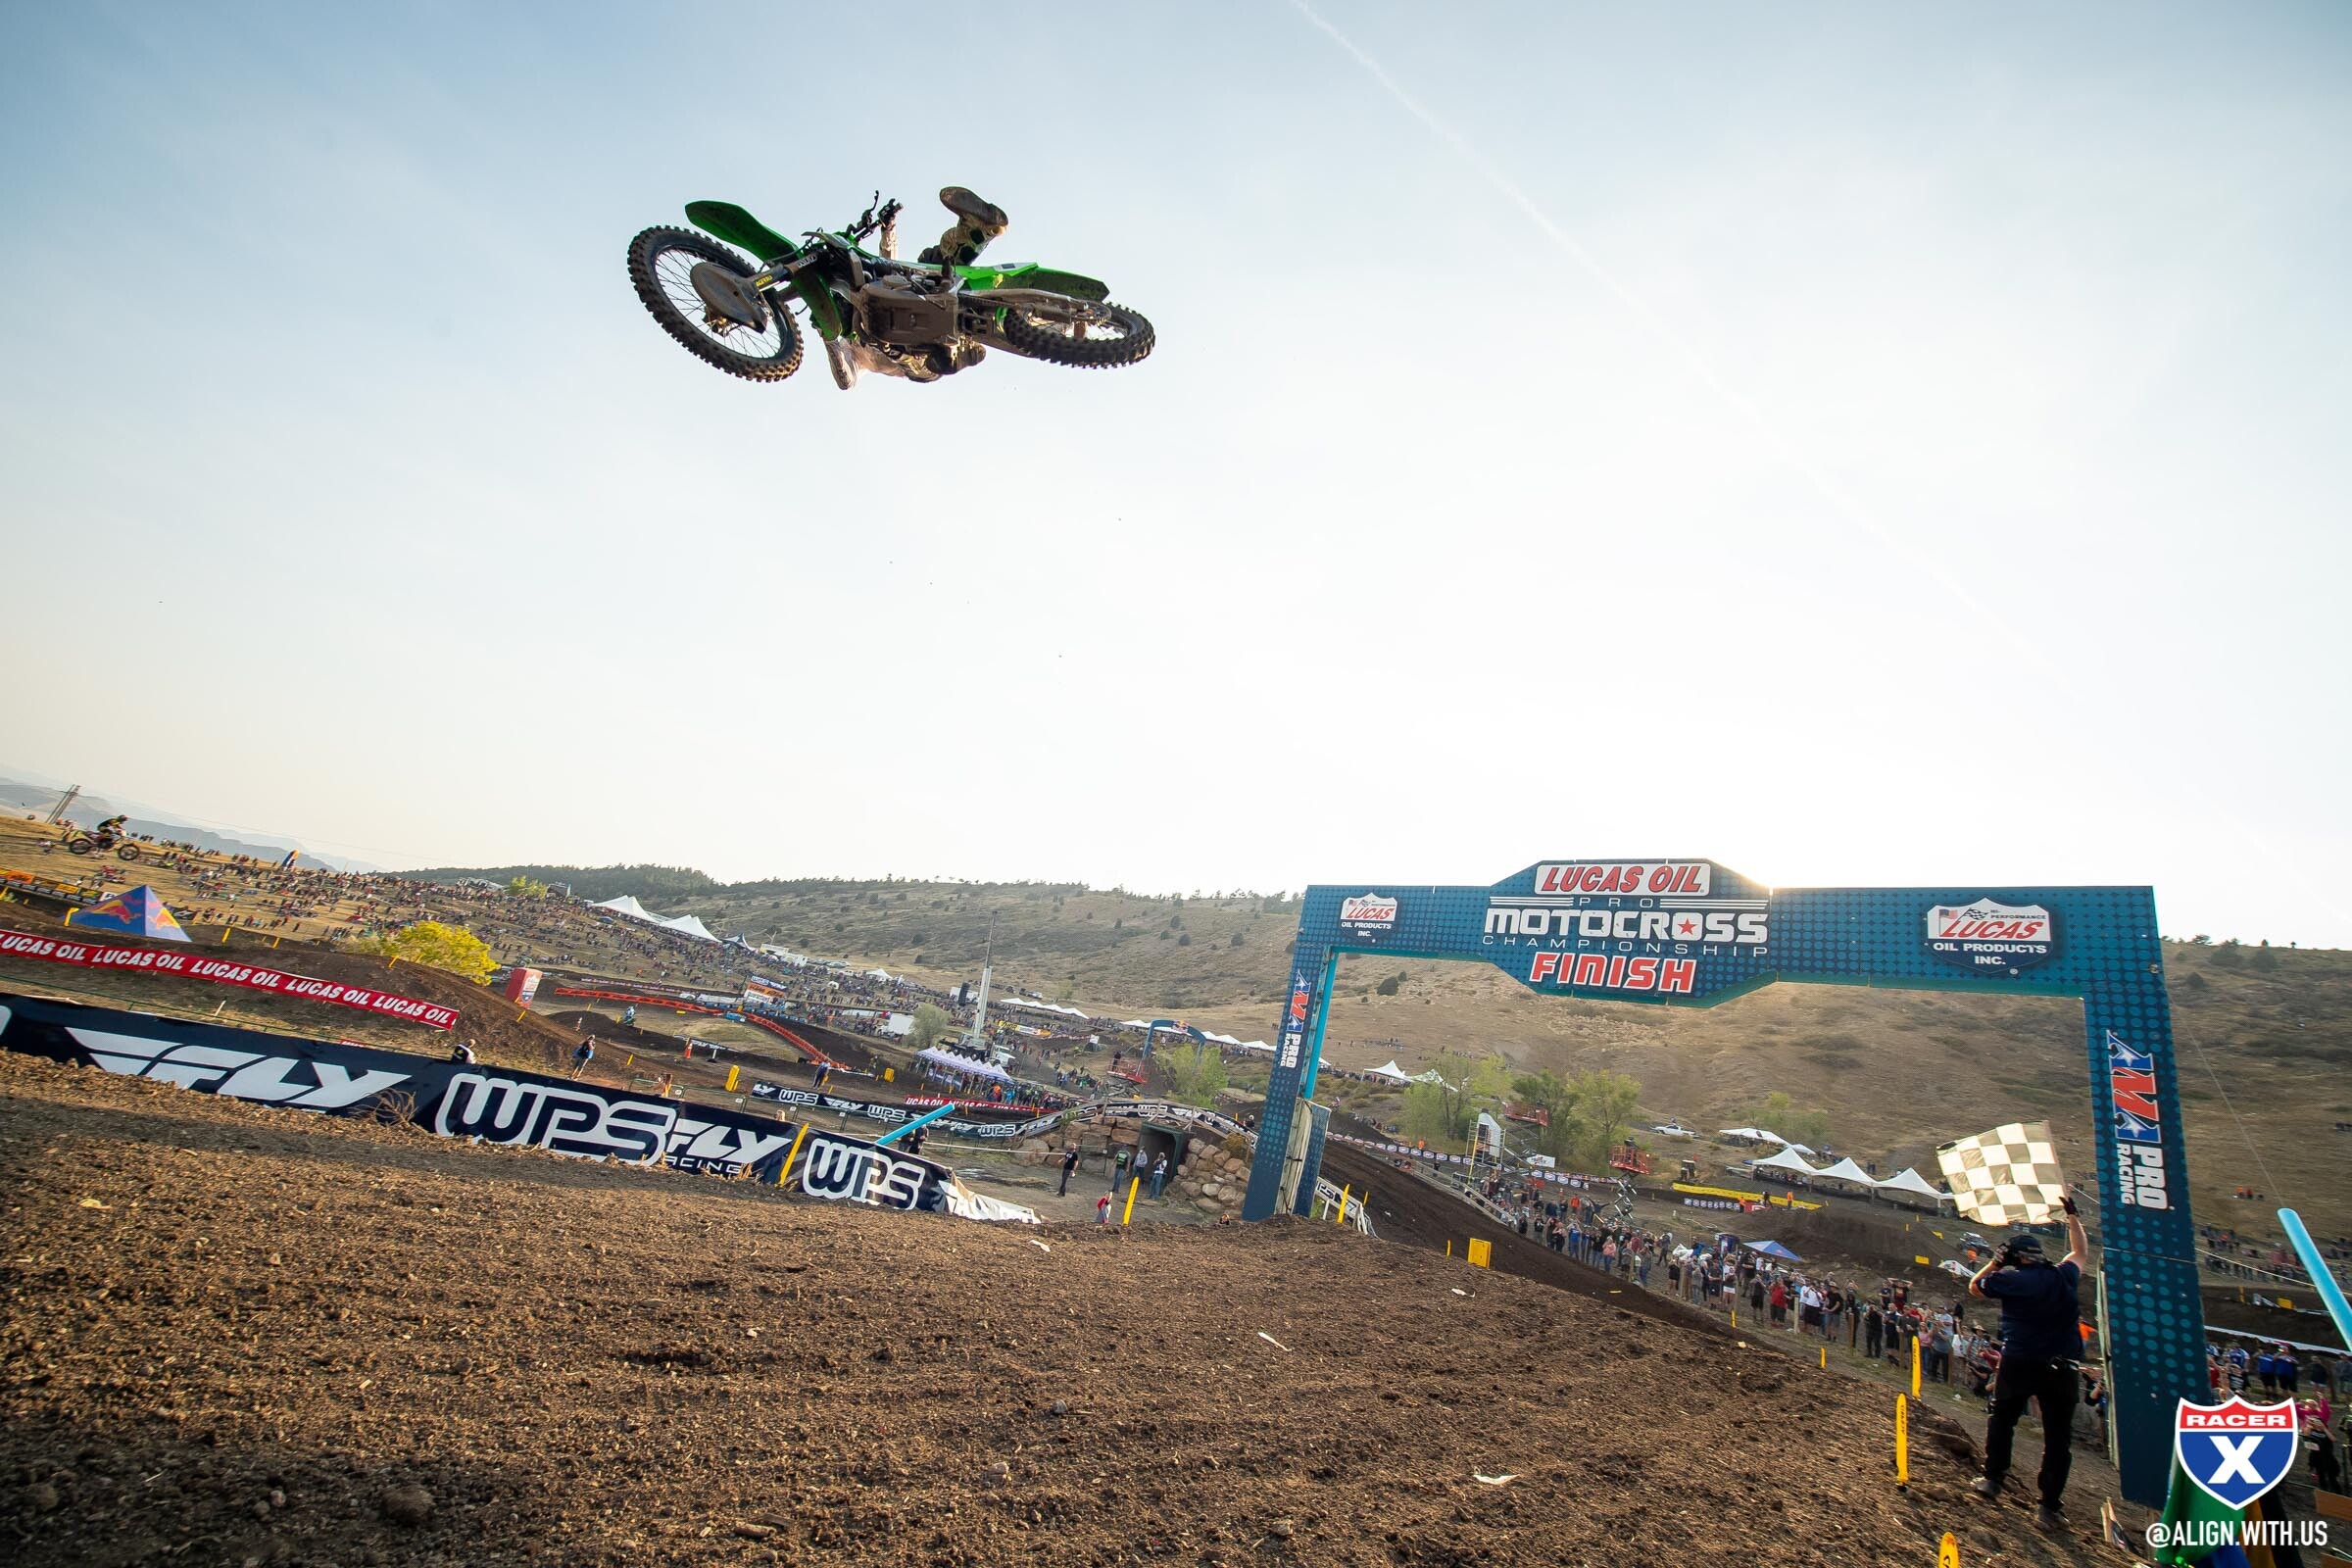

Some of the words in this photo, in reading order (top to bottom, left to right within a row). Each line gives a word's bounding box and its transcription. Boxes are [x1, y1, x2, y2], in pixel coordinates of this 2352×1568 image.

[1541, 866, 1643, 893] LUCAS
[1648, 866, 1702, 893] OIL
[1348, 907, 1396, 919] LUCAS
[1579, 898, 1653, 907] PRO
[1484, 908, 1769, 944] MOTOCROSS
[1940, 921, 2043, 939] LUCAS
[1482, 935, 1768, 956] CHAMPIONSHIP
[1963, 943, 2046, 954] PRODUCTS
[1975, 956, 2006, 964] INC.
[56, 945, 86, 960] OIL
[92, 949, 155, 966] LUCAS
[156, 955, 186, 970] OIL
[189, 960, 250, 981] LUCAS
[251, 970, 281, 987] OIL
[285, 978, 344, 999] LUCAS
[344, 989, 371, 1005] OIL
[372, 996, 426, 1016] LUCAS
[425, 1008, 452, 1024] OIL
[1529, 952, 1697, 993] FINISH
[1287, 969, 1311, 1032] AMA
[1280, 1033, 1291, 1066] RACING
[1286, 1034, 1301, 1068] PRO
[65, 1027, 412, 1107] FLY
[906, 1097, 929, 1105] UCAS
[2106, 1029, 2162, 1143] AMA
[434, 1072, 677, 1166] WPS
[779, 1089, 819, 1105] WPS
[868, 1103, 906, 1122] WPS
[666, 1118, 793, 1164] FLY
[978, 1124, 1016, 1137] WPS
[664, 1155, 742, 1174] ACING
[803, 1139, 926, 1210] WPS
[2116, 1143, 2135, 1205] RACING
[2132, 1146, 2168, 1210] PRO
